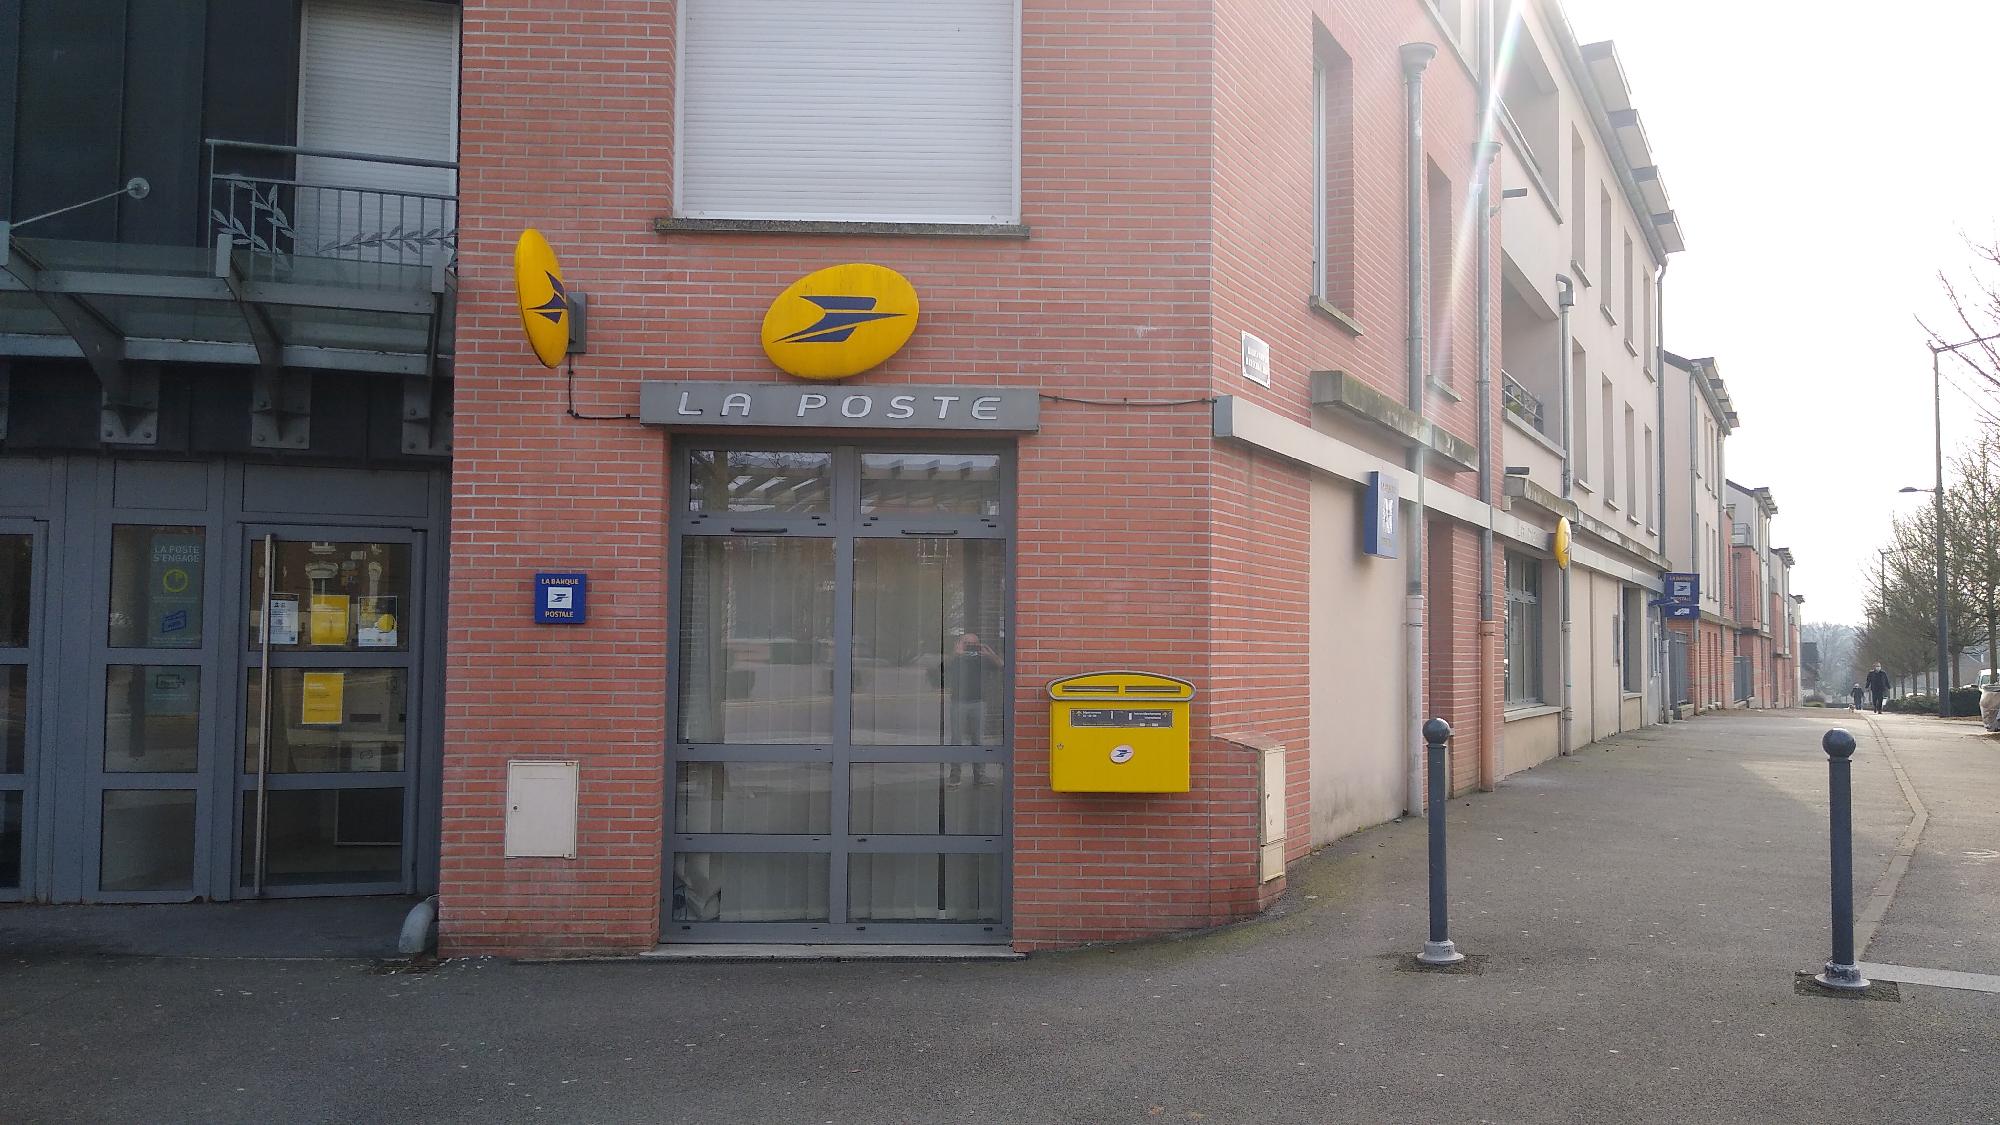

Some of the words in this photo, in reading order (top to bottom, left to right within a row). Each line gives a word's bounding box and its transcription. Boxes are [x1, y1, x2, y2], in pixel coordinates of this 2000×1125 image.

[678, 391, 752, 417] LA
[796, 393, 1001, 420] POSTE
[153, 545, 167, 554] LA
[169, 545, 200, 554] POSTE
